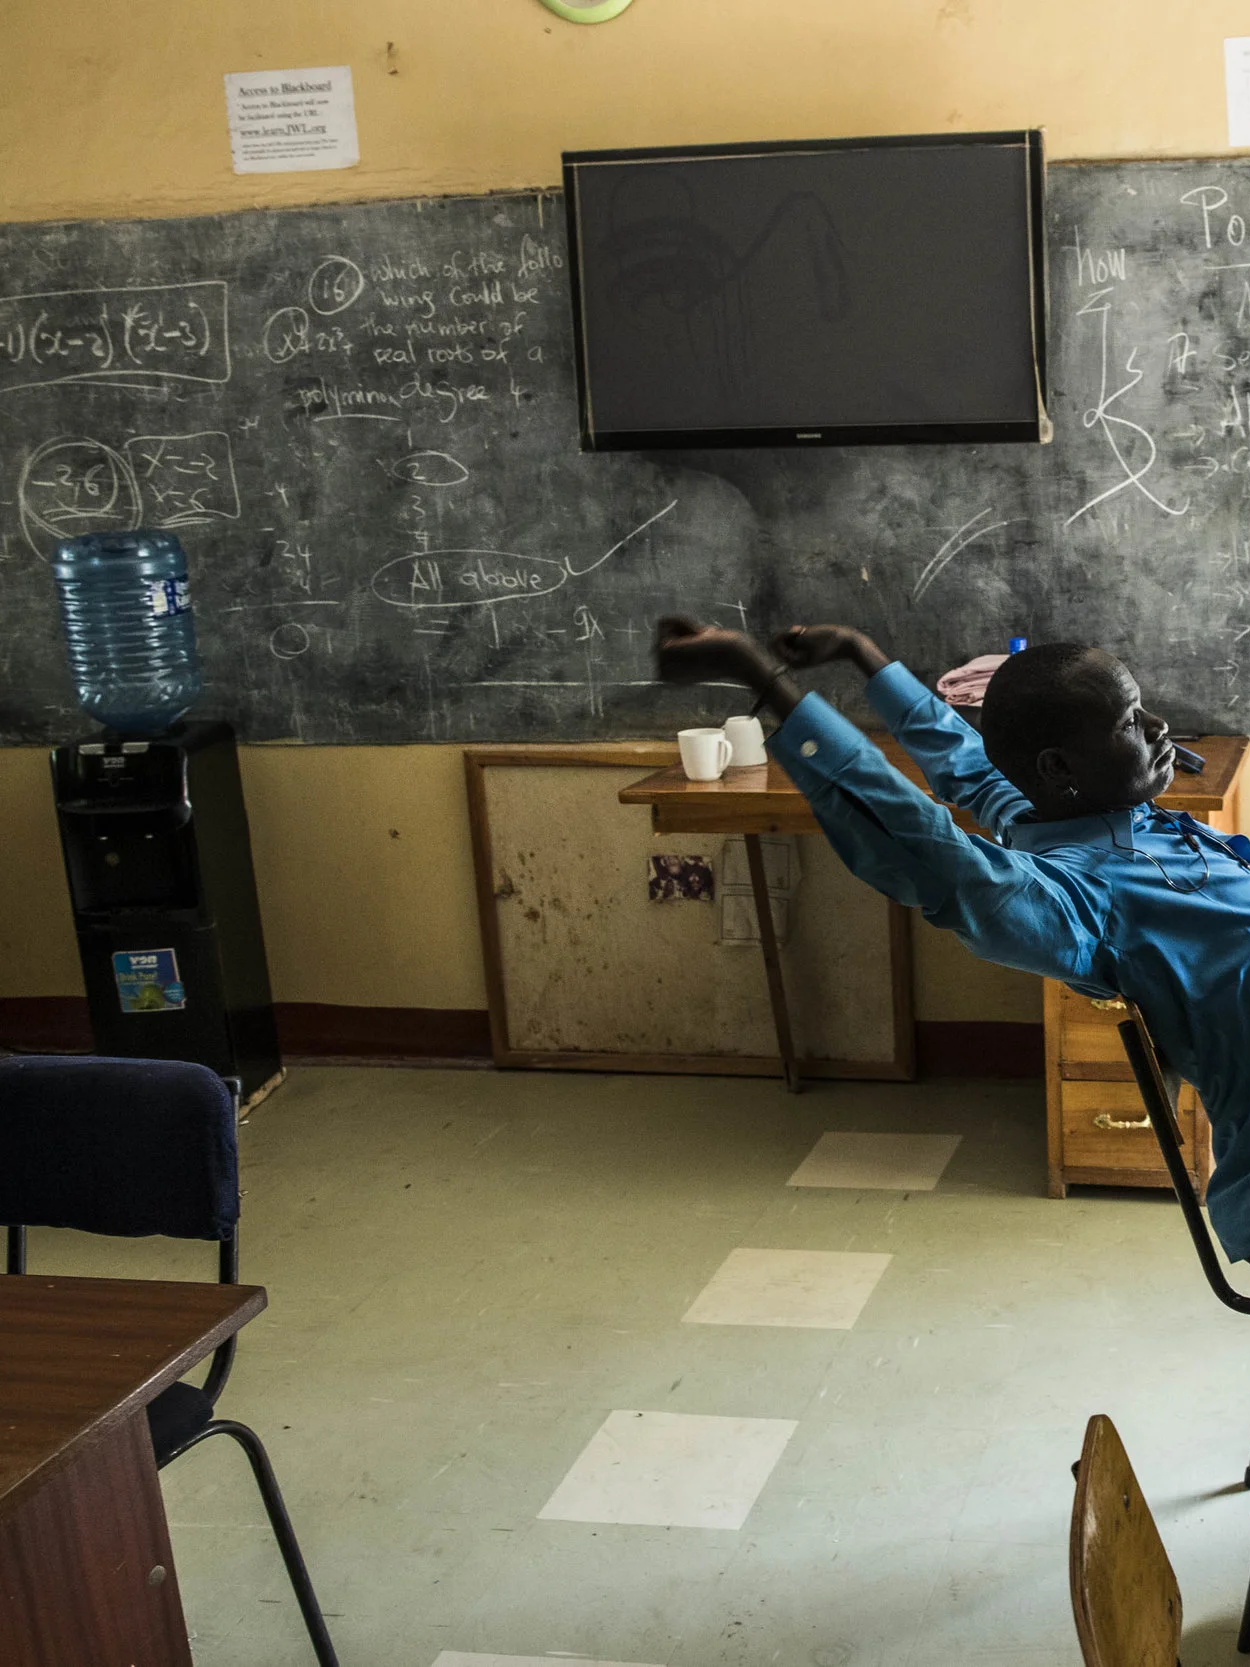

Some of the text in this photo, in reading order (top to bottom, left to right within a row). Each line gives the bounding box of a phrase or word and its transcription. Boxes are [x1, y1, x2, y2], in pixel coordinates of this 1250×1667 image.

[240, 80, 332, 97] Access to Blackboard
[370, 253, 430, 282] which
[443, 251, 465, 279] of
[468, 251, 505, 275] the
[381, 289, 436, 319] wing
[511, 282, 540, 304] be
[360, 311, 527, 337] the number of
[373, 340, 417, 365] real
[427, 345, 473, 364] roots
[527, 345, 544, 365] a
[399, 372, 492, 424] degree
[459, 559, 543, 592] above
